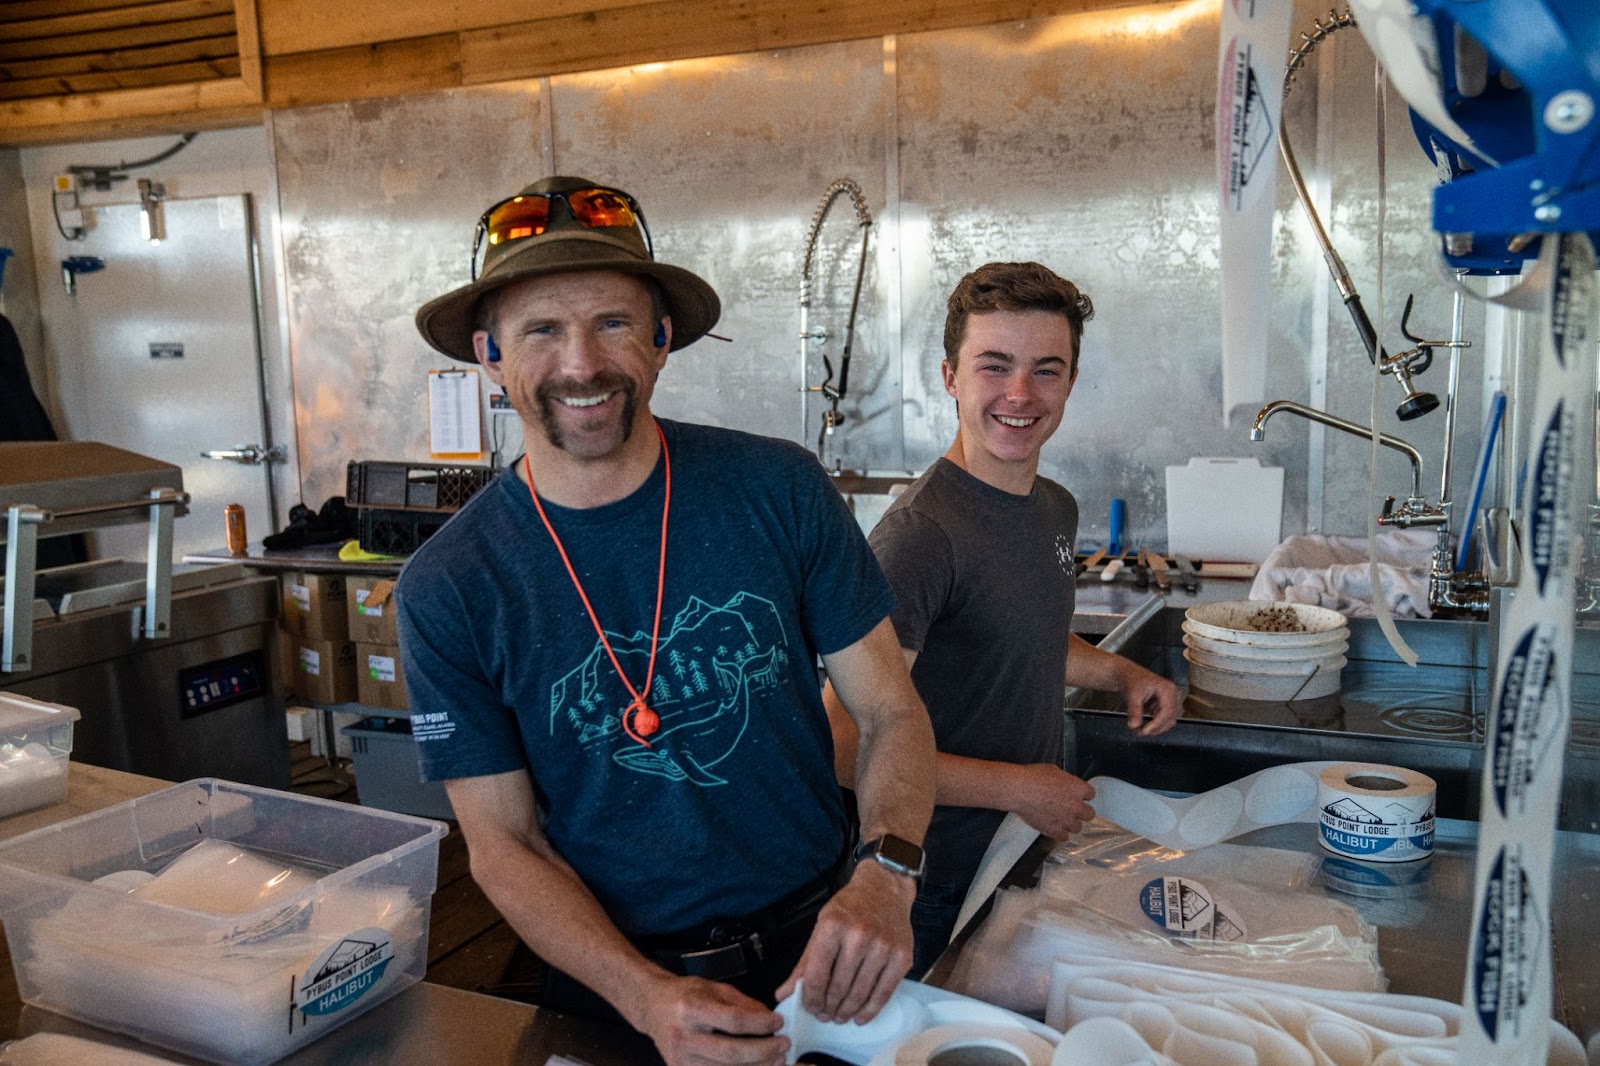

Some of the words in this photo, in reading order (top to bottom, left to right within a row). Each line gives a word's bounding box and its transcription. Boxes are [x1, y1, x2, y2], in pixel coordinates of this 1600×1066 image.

[1502, 655, 1526, 726] ROCK
[425, 711, 449, 724] POINT
[1495, 730, 1512, 787] FISH
[1320, 814, 1336, 826] PYBUS
[1338, 820, 1360, 833] POINT
[1363, 825, 1390, 835] LODGE
[1326, 827, 1379, 850] HALIBUT
[1149, 886, 1163, 917] HALIBUT
[1169, 908, 1180, 924] LODGE
[1486, 879, 1502, 953] ROCK
[306, 978, 333, 1000] PYBUS
[335, 964, 357, 983] POINT
[360, 949, 383, 970] LODGE
[320, 970, 374, 1012] HALIBUT
[1480, 956, 1499, 1013] FISH
